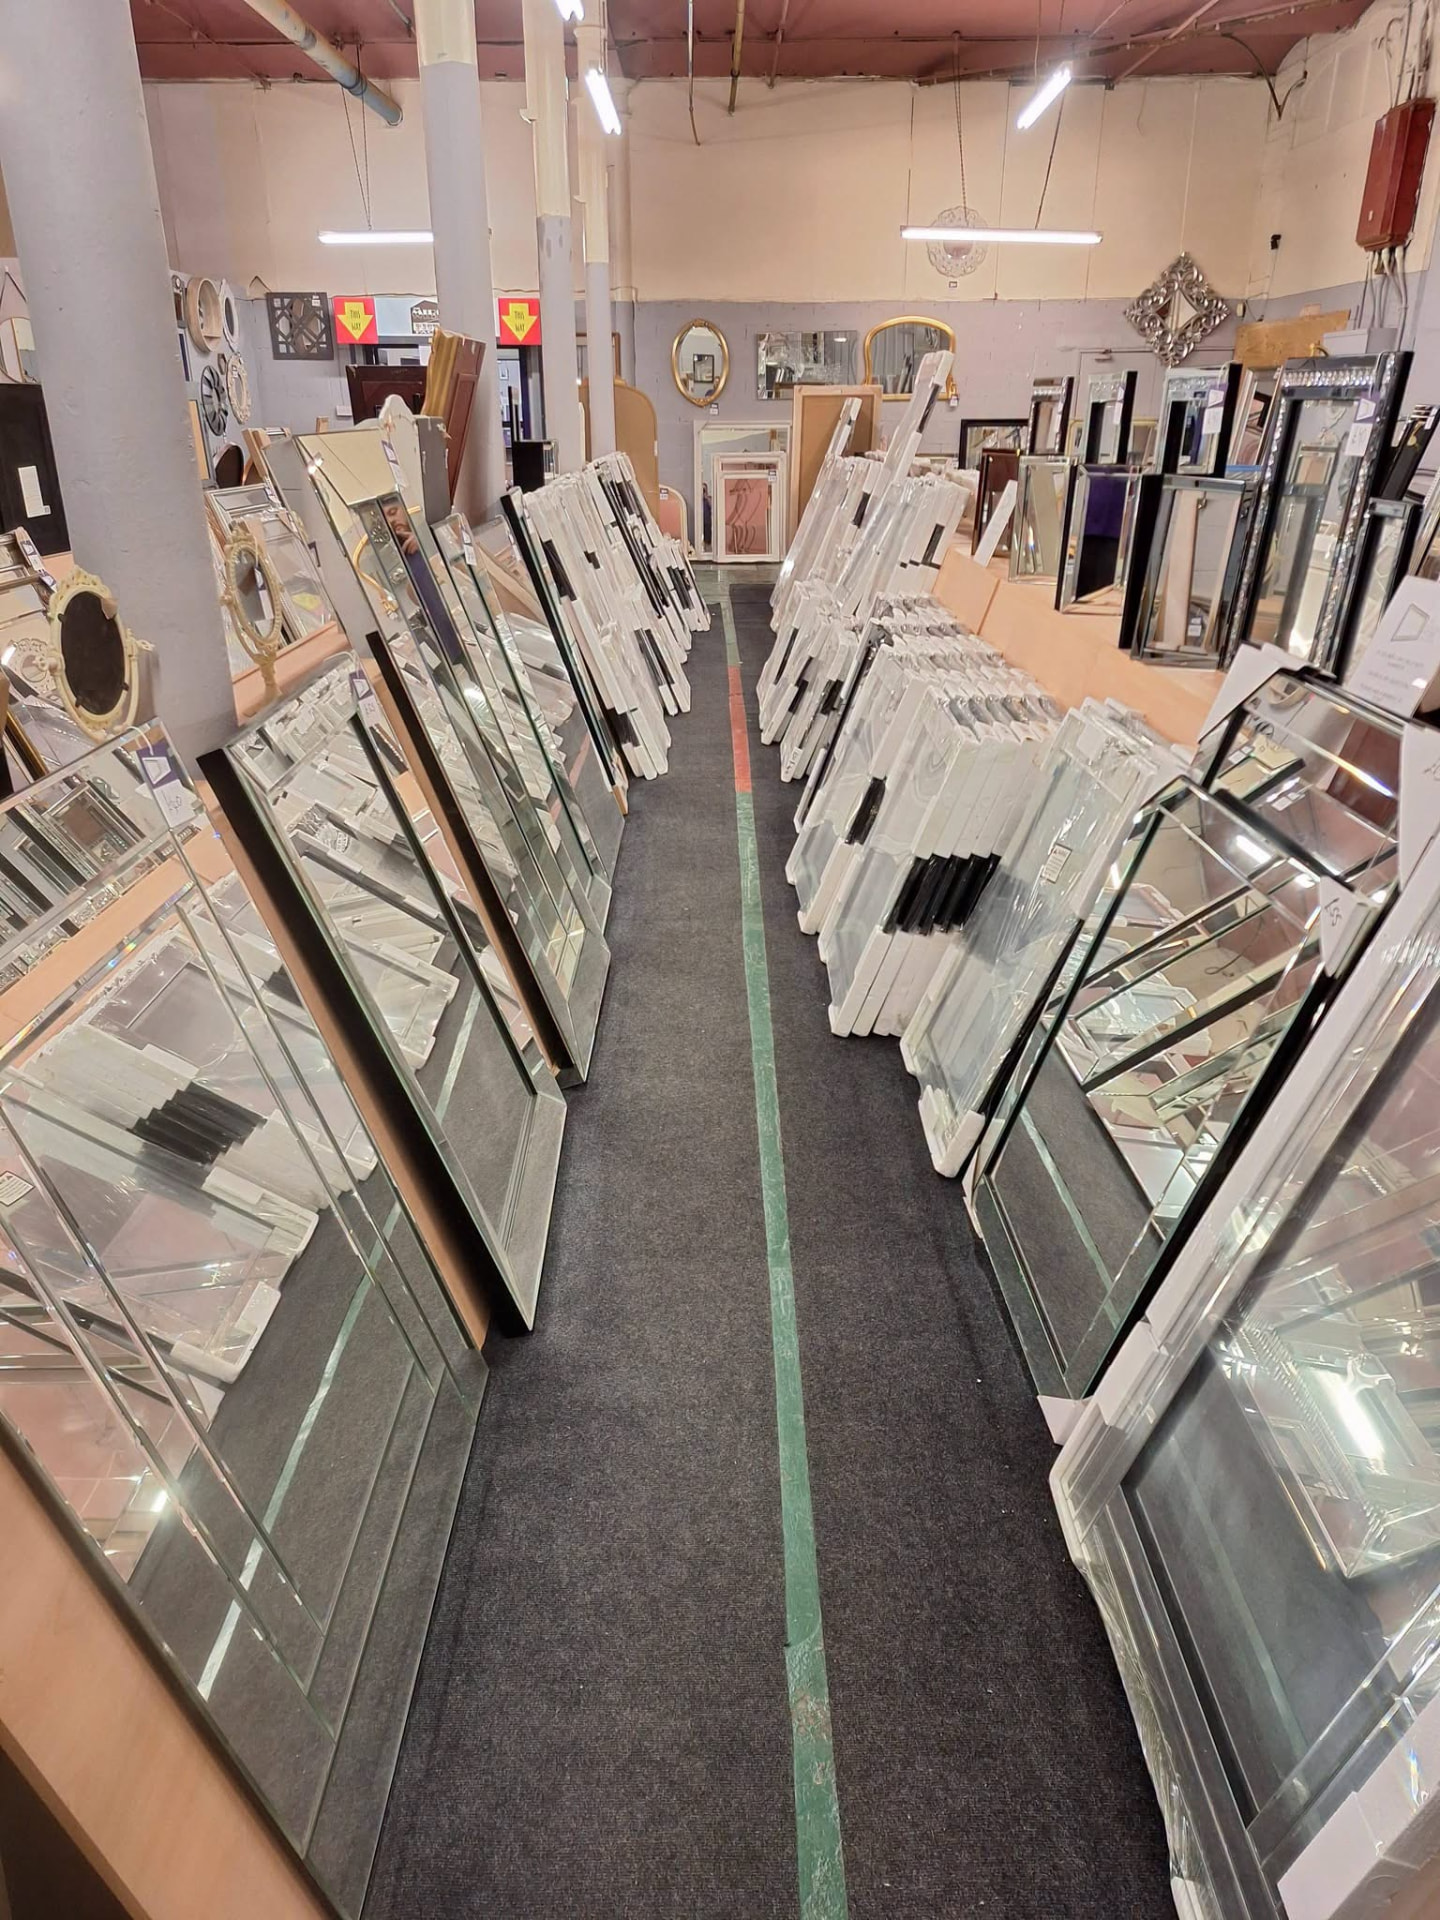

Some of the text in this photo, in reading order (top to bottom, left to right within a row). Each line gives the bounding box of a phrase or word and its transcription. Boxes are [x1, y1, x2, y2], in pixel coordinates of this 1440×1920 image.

[350, 309, 361, 319] THIS
[514, 310, 525, 320] THIS
[351, 322, 361, 331] WAY
[515, 323, 525, 332] WAY
